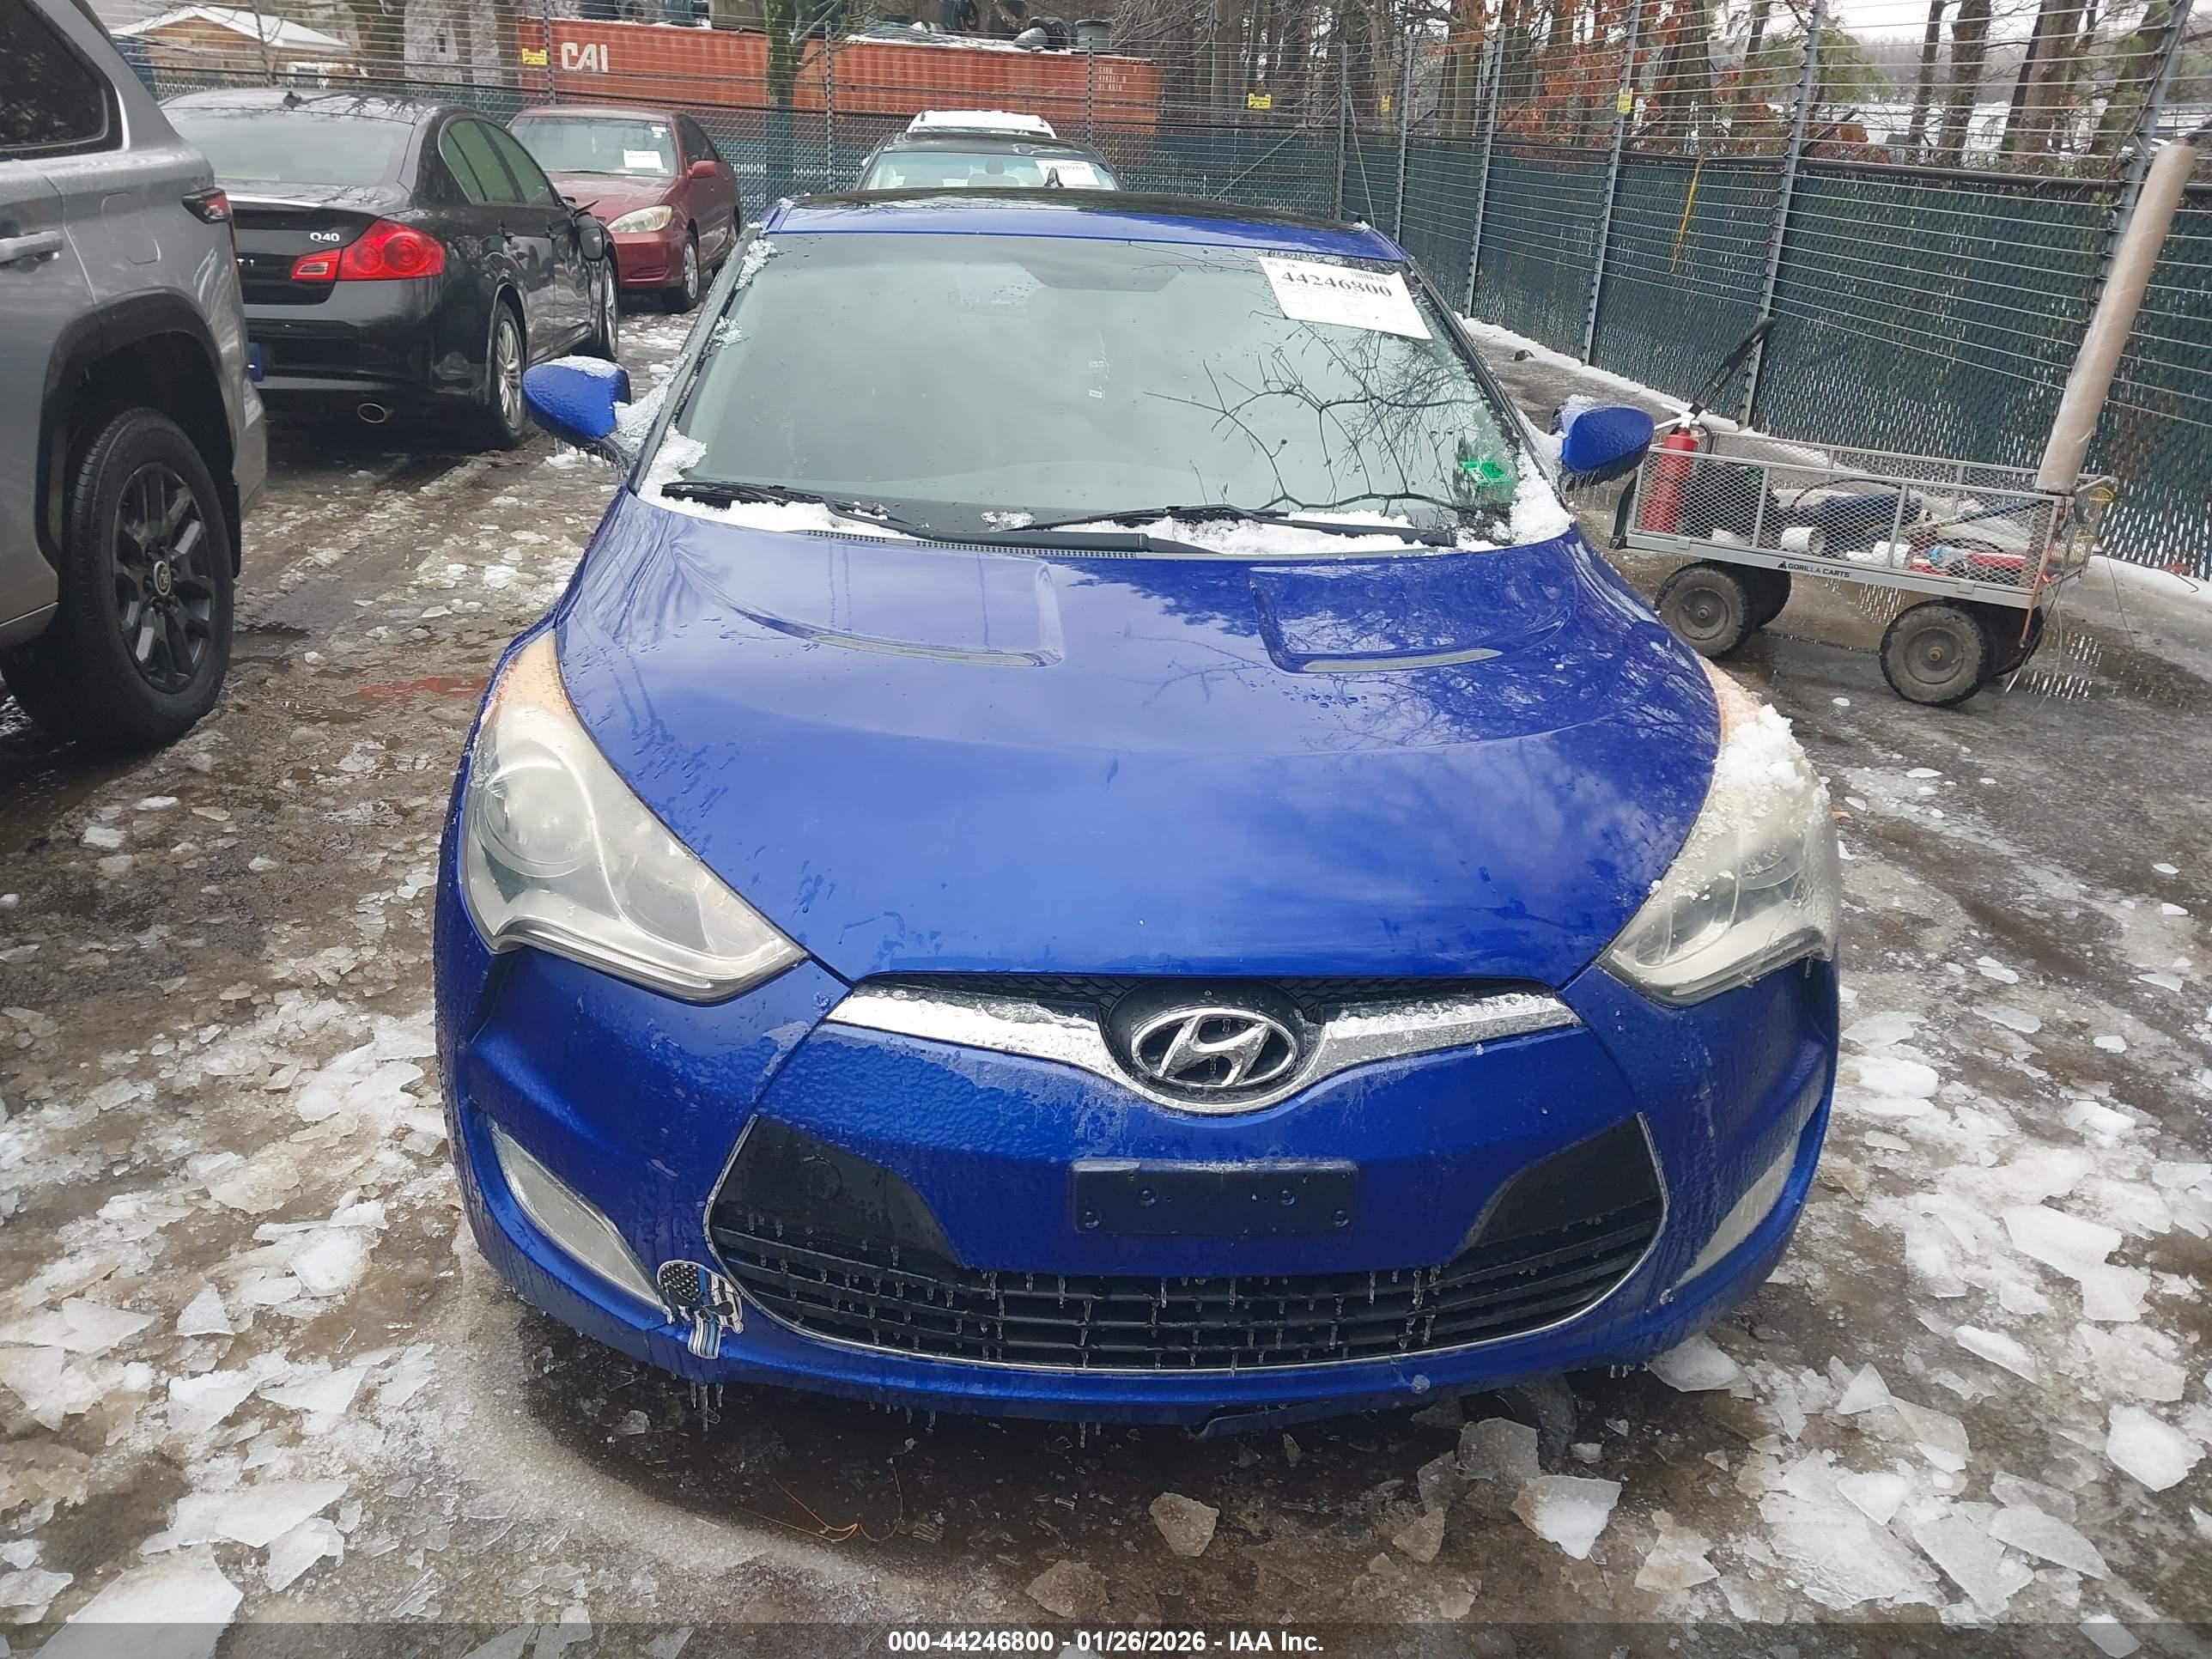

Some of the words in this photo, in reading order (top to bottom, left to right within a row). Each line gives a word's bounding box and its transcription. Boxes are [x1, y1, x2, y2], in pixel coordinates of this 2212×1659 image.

[561, 42, 609, 73] CAI
[309, 232, 340, 242] Q40
[1281, 271, 1393, 297] 44246800
[1788, 562, 1820, 574] GORILLA
[1822, 568, 1852, 578] CARTS
